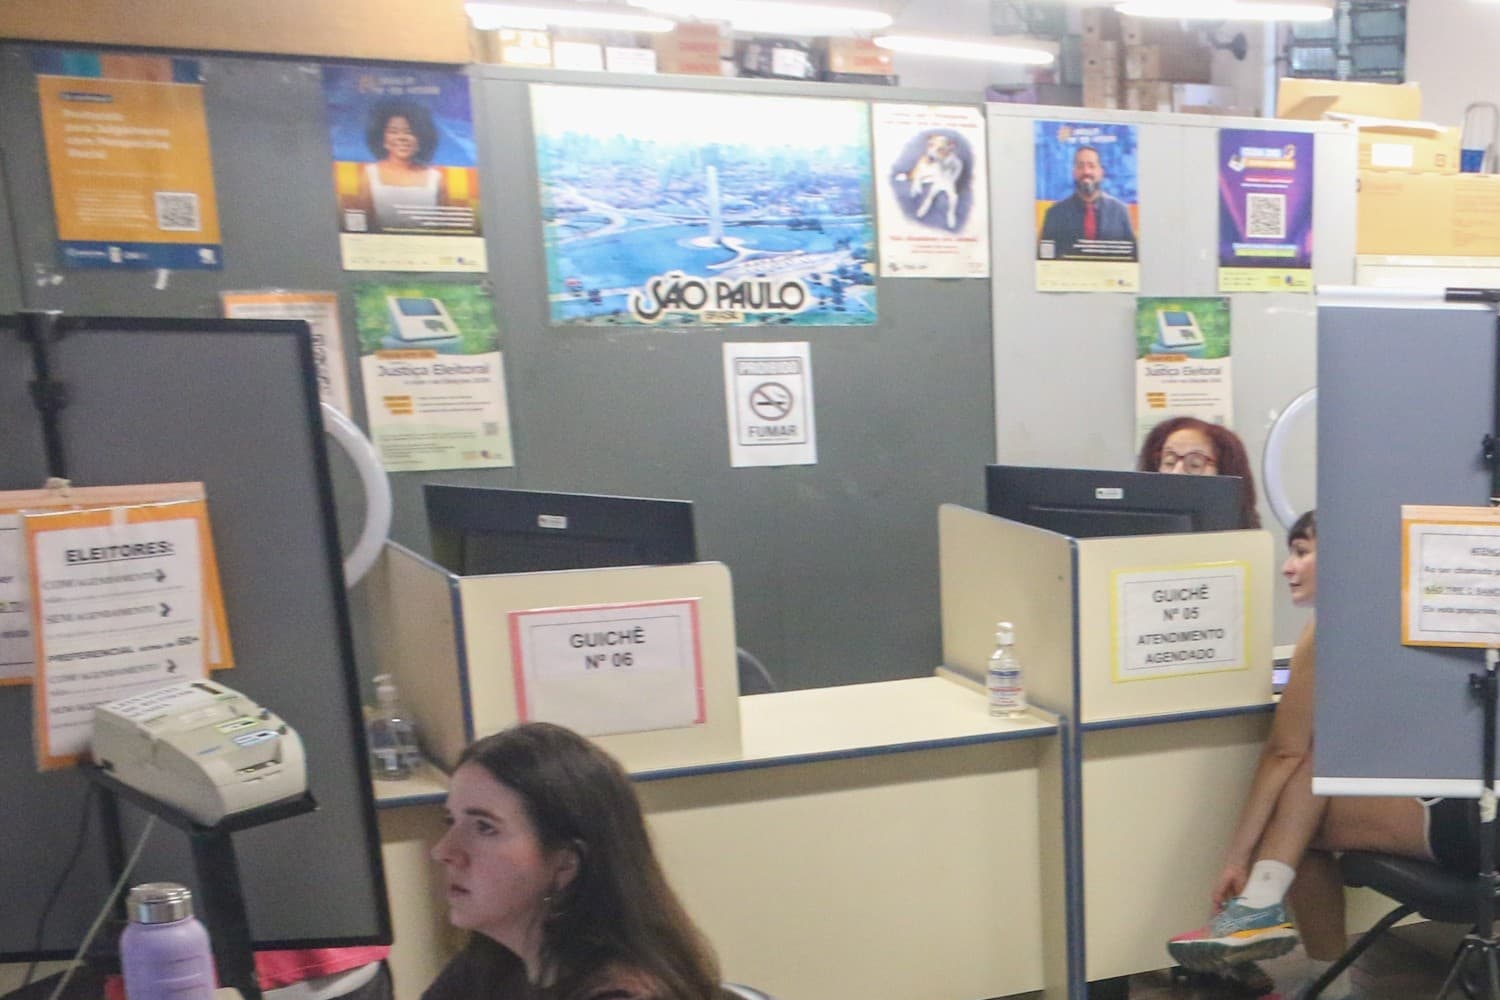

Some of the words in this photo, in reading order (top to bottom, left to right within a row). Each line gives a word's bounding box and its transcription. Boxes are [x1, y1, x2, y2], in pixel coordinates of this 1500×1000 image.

[634, 274, 708, 320] SÃO
[715, 280, 805, 310] PAULO
[433, 363, 490, 376] Eleitoral
[748, 425, 798, 438] FUMAR
[64, 540, 175, 563] ELEITORES:
[1152, 584, 1209, 603] GUICHÊ
[1183, 606, 1200, 620] 05
[569, 626, 646, 648] GUICHÊ
[1136, 628, 1225, 646] ATENDIMENTO
[585, 653, 606, 670] Nº
[611, 652, 635, 668] 06
[1145, 647, 1215, 664] AGENDADO
